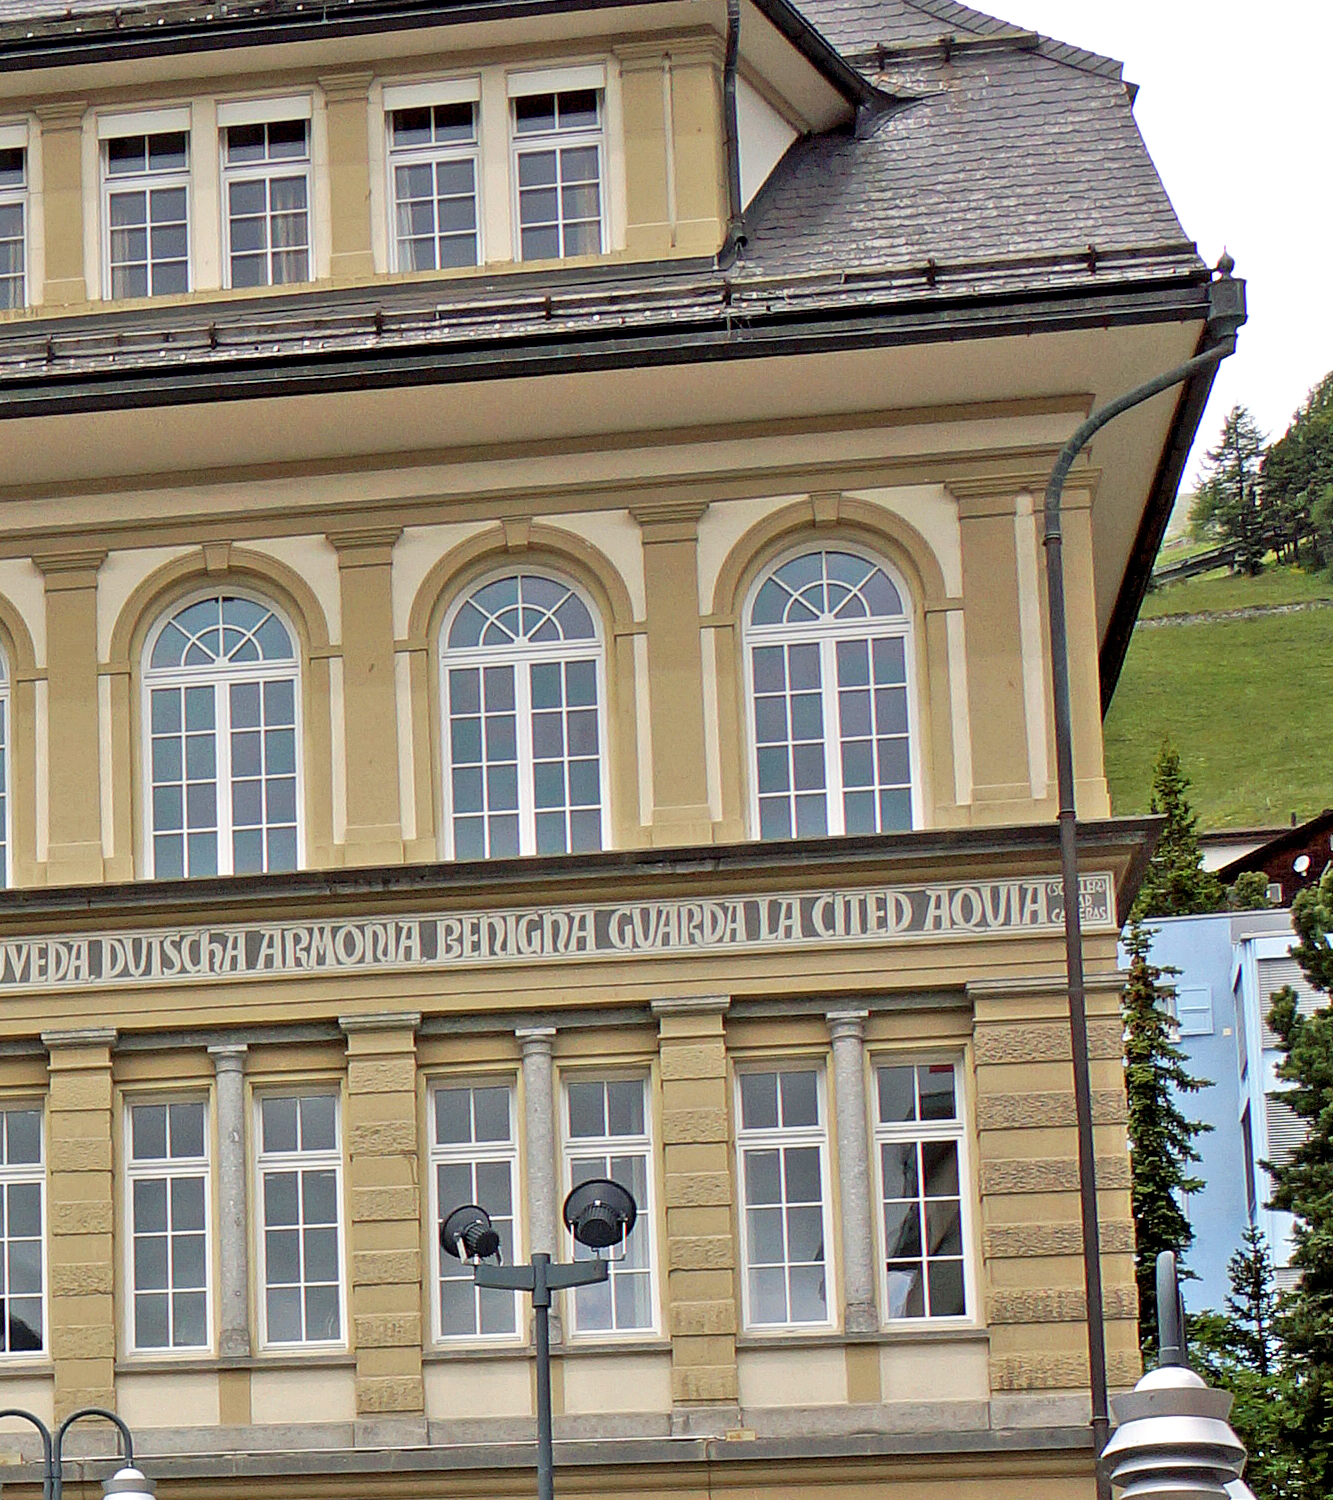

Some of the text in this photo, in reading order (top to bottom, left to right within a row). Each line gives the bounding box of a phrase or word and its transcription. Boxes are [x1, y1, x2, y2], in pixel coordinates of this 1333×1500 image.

[1047, 879, 1106, 896] (SCLER)
[1051, 907, 1106, 922] CAERAS
[102, 931, 246, 979] DUTSCHA
[437, 908, 596, 960] BENIGNA
[608, 900, 747, 950] GUARDA
[758, 898, 802, 940] LA
[812, 891, 913, 938] CITED
[924, 882, 1048, 932] AQUIA
